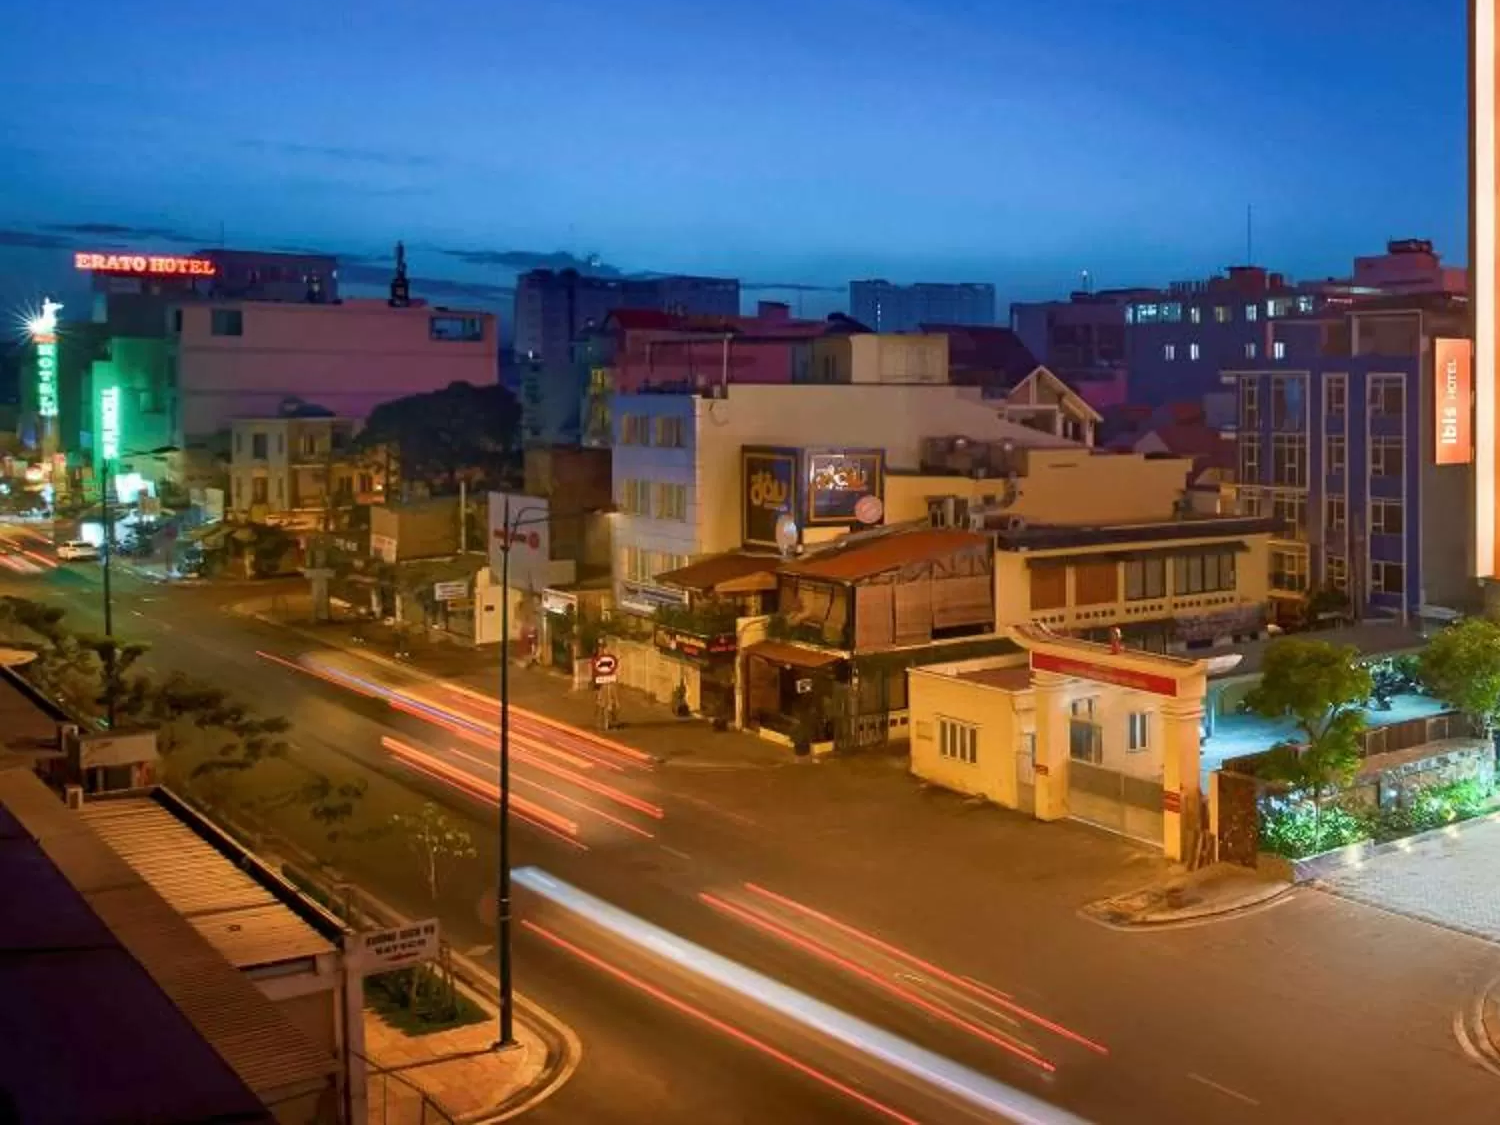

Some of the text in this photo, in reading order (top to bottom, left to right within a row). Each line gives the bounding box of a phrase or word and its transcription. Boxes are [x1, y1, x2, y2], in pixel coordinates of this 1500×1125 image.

[75, 253, 217, 275] ERATO HOTEL
[1440, 359, 1457, 444] ibis HOTEL
